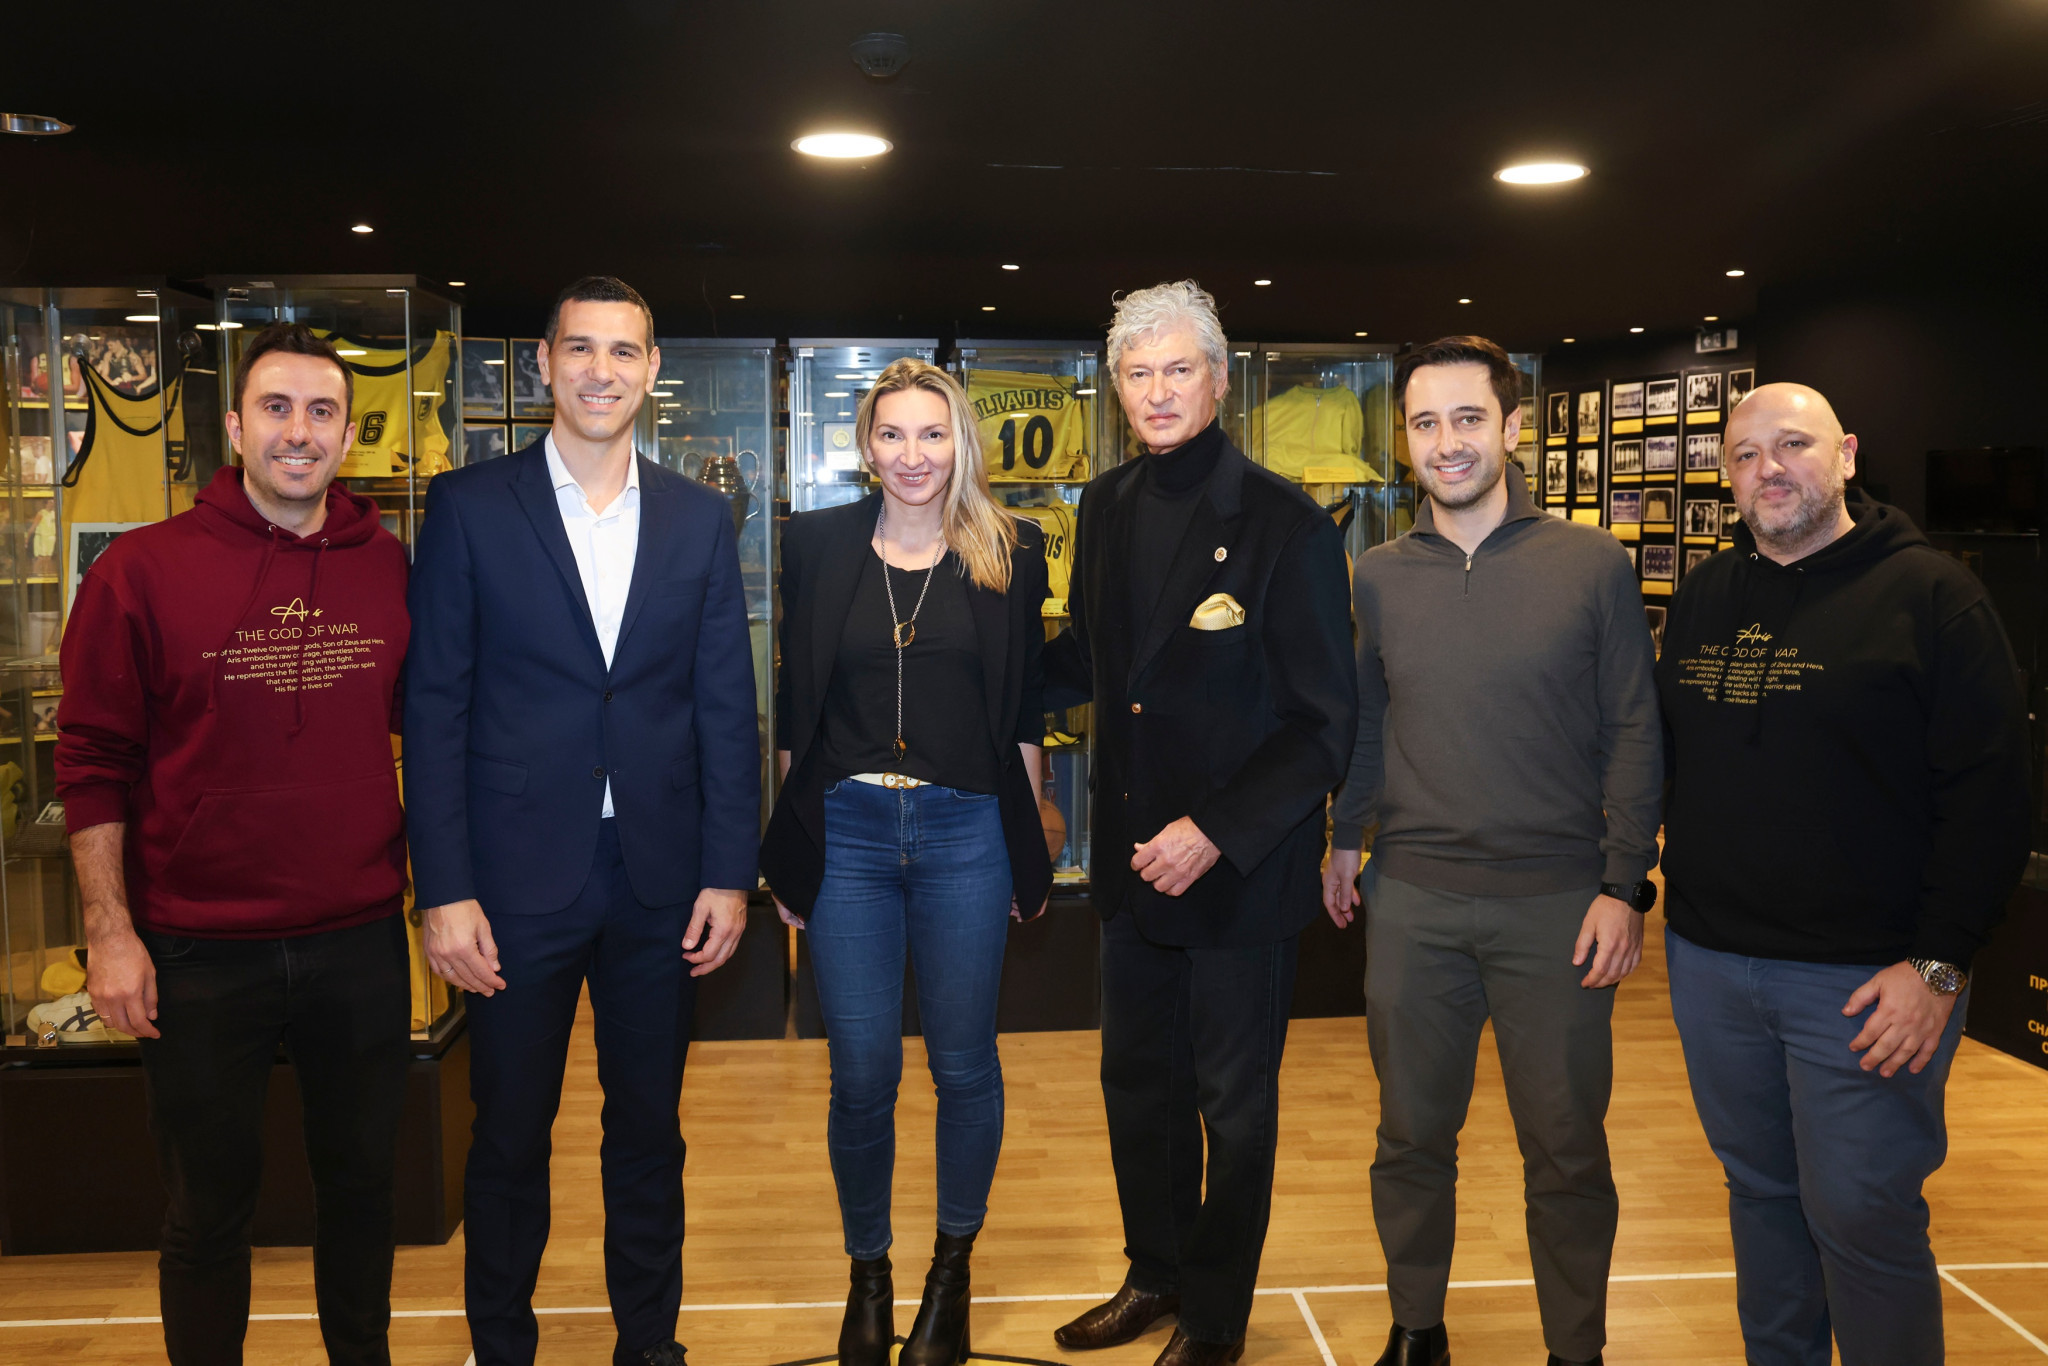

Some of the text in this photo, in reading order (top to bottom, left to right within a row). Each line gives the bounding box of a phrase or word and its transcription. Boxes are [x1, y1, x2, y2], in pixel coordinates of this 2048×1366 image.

[975, 389, 1066, 421] LIADIS
[358, 411, 387, 445] 6
[998, 415, 1054, 471] 10
[270, 597, 323, 625] Ars
[235, 629, 266, 642] THE
[268, 627, 303, 640] GOD
[328, 623, 359, 635] WAR
[1736, 622, 1774, 645] Aris
[220, 649, 228, 657] of
[242, 654, 278, 662] embodies
[322, 648, 354, 656] relentless
[1700, 644, 1720, 656] THE
[1750, 648, 1768, 658] OF
[236, 672, 275, 680] represents
[360, 661, 376, 669] spirit
[278, 660, 314, 669] unyieing
[302, 674, 322, 682] backs
[308, 682, 322, 690] lives
[2029, 974, 2048, 992] ΠΡ
